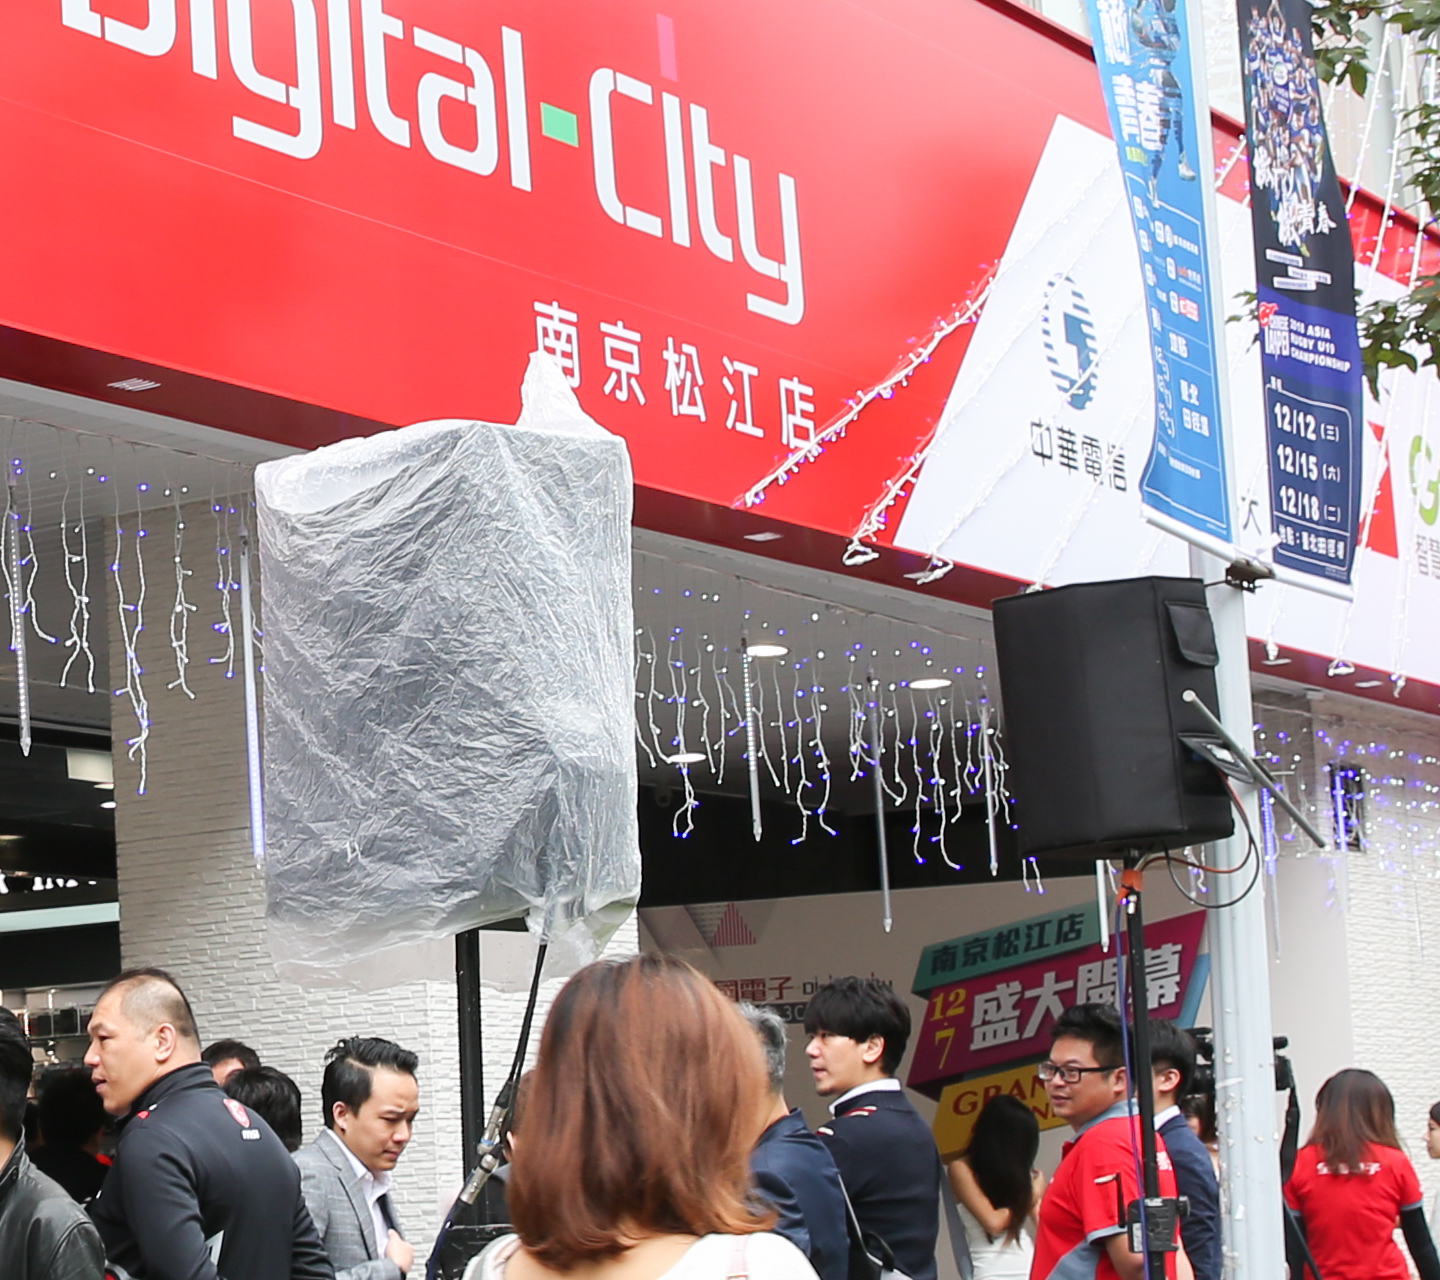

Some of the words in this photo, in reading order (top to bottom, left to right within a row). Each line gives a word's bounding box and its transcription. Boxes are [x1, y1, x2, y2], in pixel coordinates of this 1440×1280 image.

[1306, 324, 1331, 340] ASIA
[1317, 340, 1336, 355] U19
[532, 300, 818, 451] 南京松江店
[1274, 402, 1317, 441] 12/12
[1277, 443, 1319, 481] 12/15
[1279, 485, 1321, 521] 12/18
[930, 912, 1086, 976] 南京松江店
[952, 1071, 1046, 1117] GRAN
